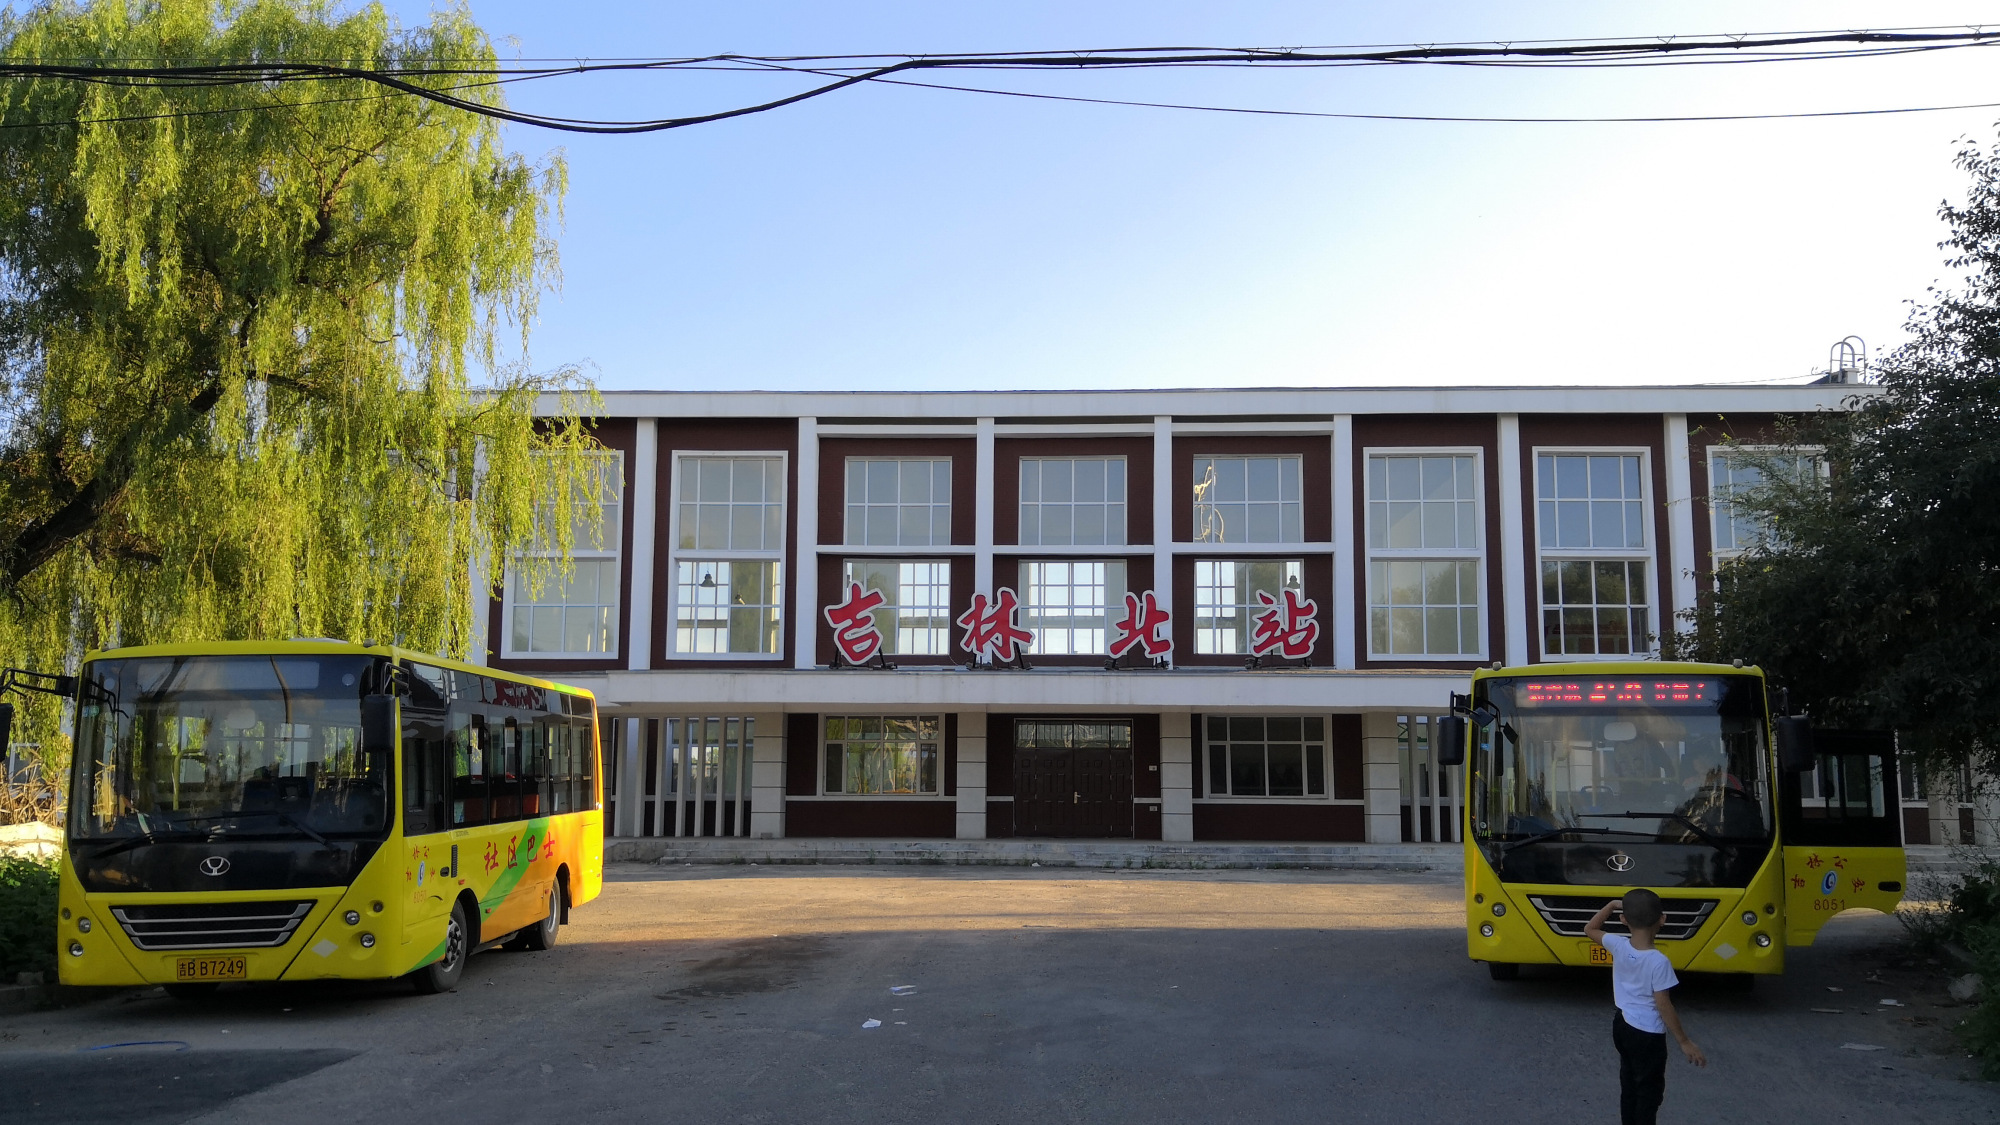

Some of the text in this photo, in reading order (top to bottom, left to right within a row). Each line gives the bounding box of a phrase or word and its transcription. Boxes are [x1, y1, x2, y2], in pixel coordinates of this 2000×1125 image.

[824, 580, 1319, 665] 吉林北站
[484, 831, 555, 877] 社区巴士
[1814, 898, 1845, 911] 8051
